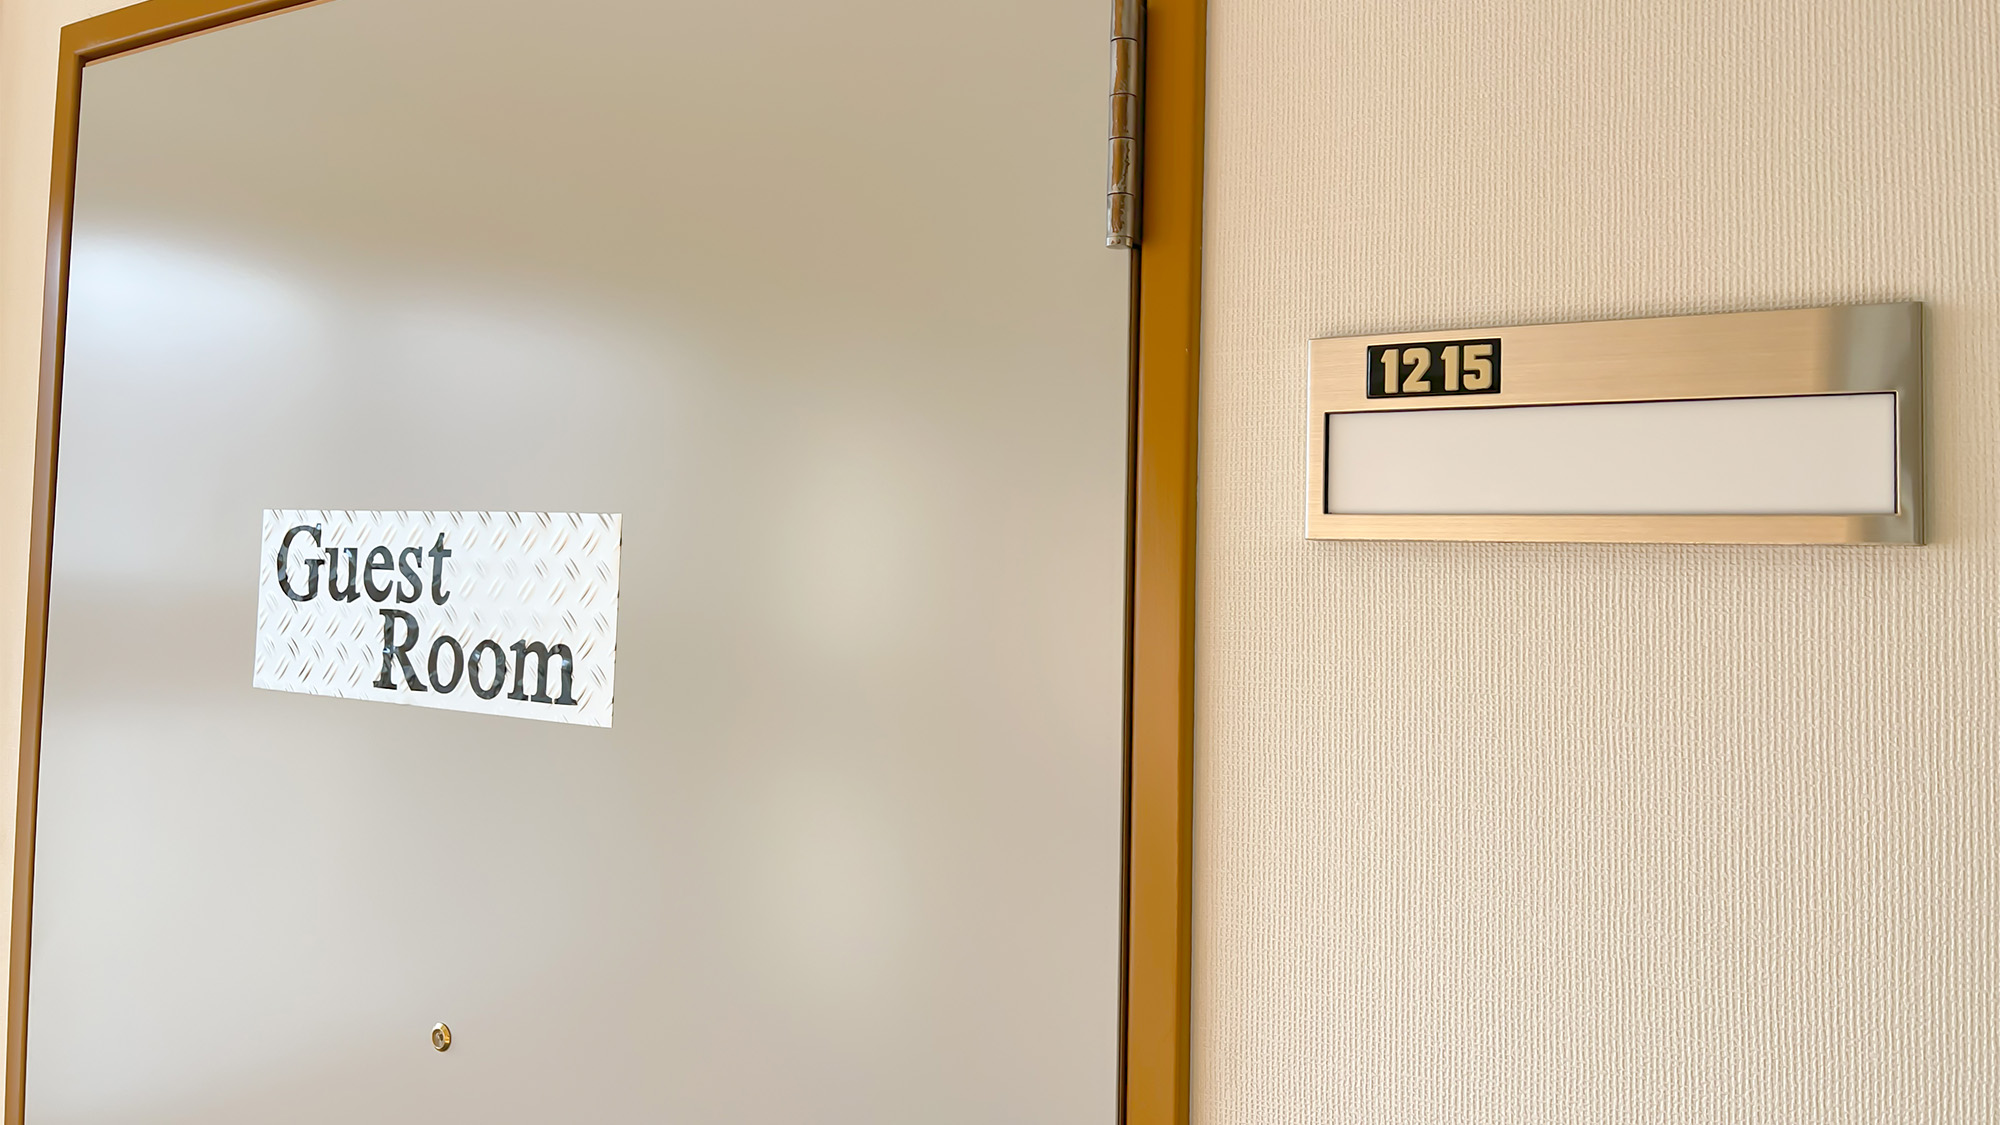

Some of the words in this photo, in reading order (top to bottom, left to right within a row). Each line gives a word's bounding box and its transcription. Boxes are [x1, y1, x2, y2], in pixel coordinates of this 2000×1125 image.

[1380, 344, 1493, 394] 1215
[276, 523, 452, 606] Guest
[372, 608, 579, 706] Room
